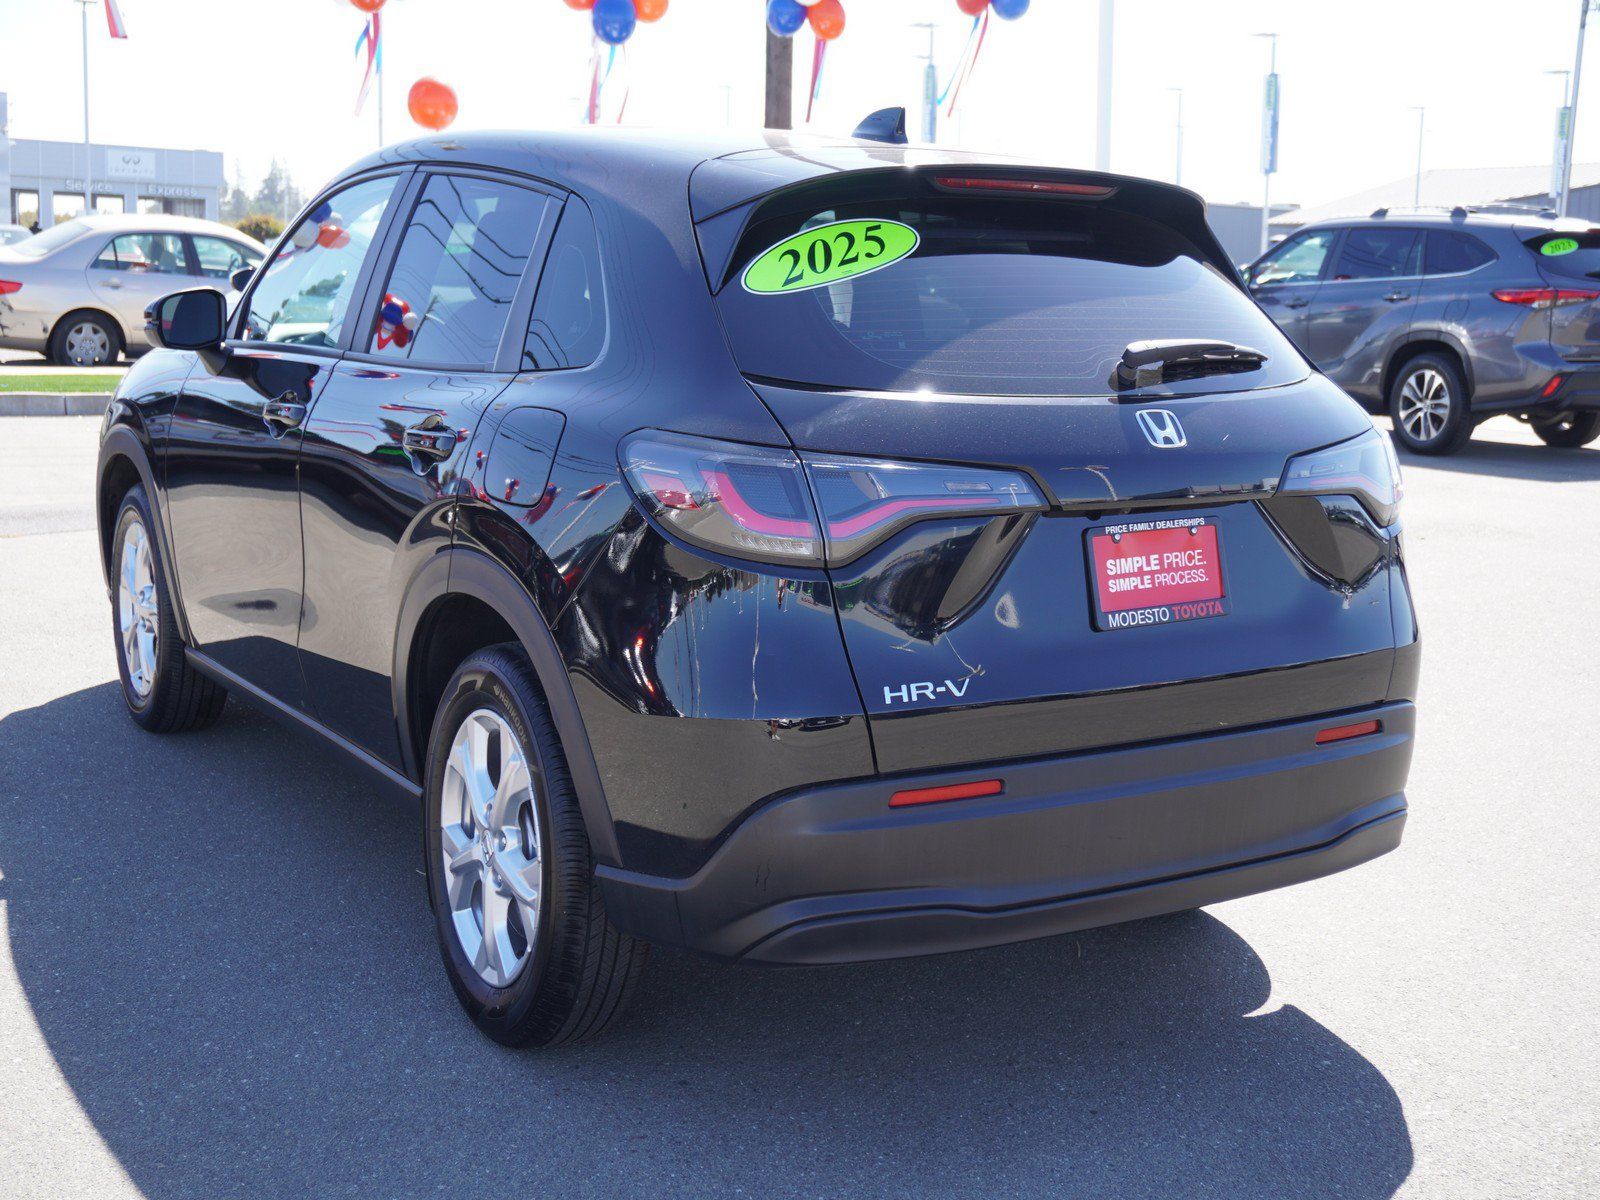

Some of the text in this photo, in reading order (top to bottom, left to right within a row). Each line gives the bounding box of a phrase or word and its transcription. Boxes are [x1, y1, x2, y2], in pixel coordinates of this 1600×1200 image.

[147, 184, 198, 197] Express
[778, 224, 886, 287] 2025
[1105, 517, 1205, 534] PRICE FAMILY DEALERSHIPS
[1106, 549, 1207, 576] SIMPLE PRICE.
[1108, 568, 1209, 593] SIMPLE PROCESS.
[1108, 601, 1224, 628] MODESTO TOYOTA
[883, 678, 970, 705] HR-V
